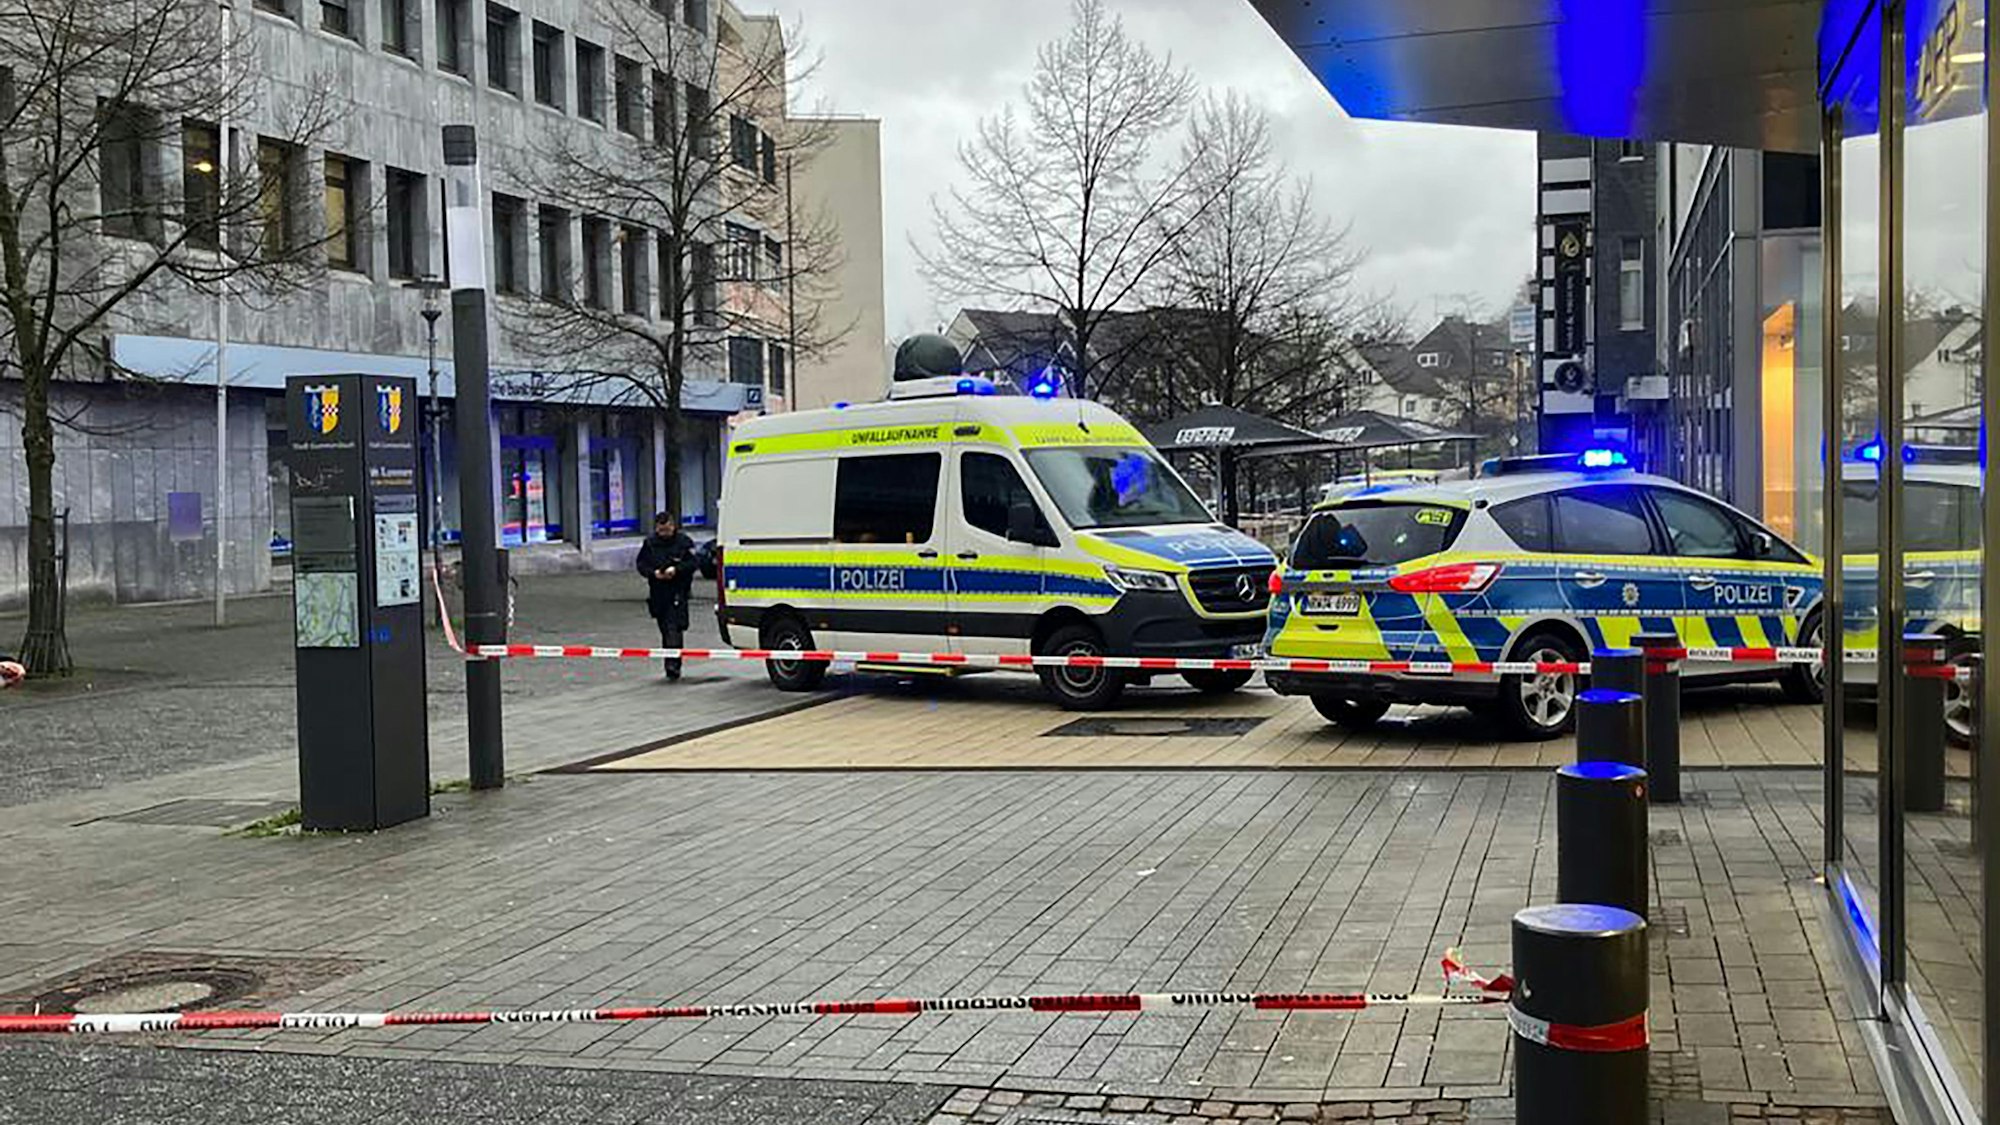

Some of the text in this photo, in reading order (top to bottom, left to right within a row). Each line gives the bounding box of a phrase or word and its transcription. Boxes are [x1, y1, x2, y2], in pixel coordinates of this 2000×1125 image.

[851, 427, 939, 444] UNFALLAUFNAHME
[841, 569, 905, 590] POLIZEI
[1714, 584, 1772, 605] POLIZEI
